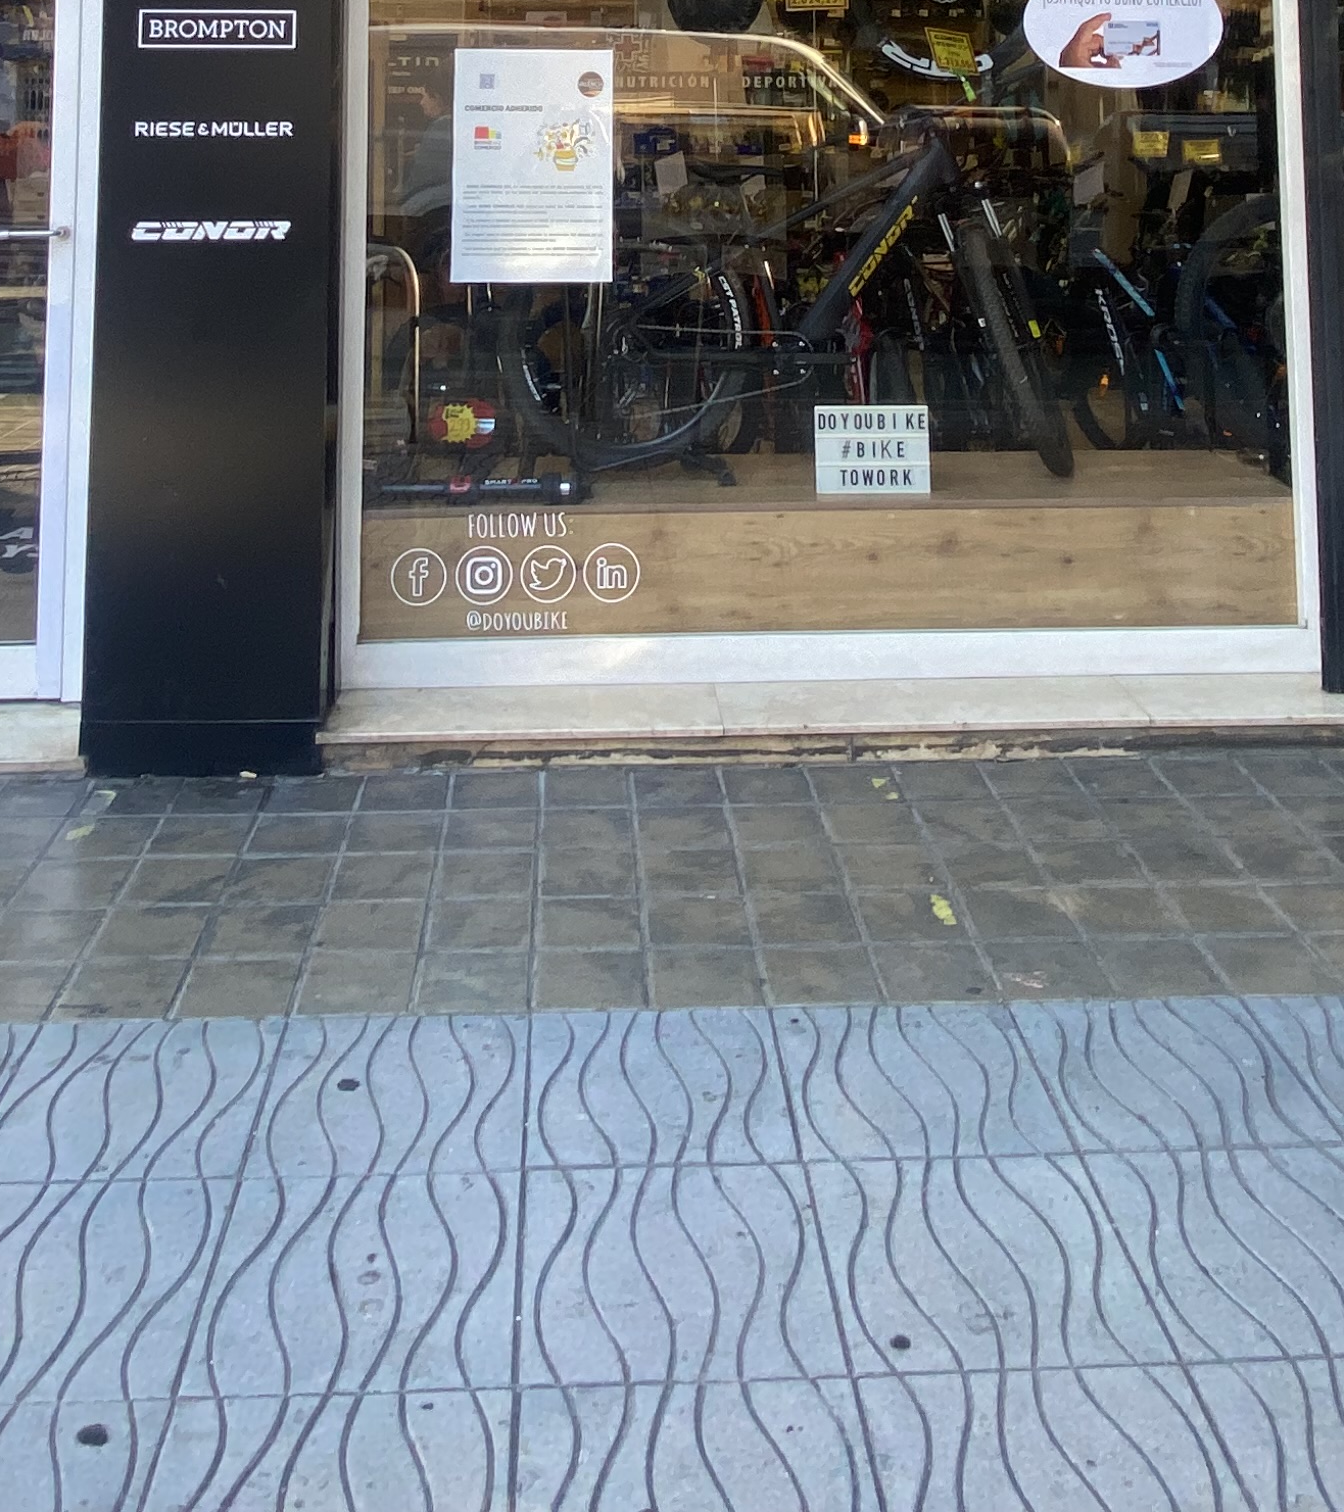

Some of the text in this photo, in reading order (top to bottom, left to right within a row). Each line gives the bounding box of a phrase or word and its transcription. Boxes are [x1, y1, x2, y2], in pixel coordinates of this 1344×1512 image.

[149, 19, 286, 39] BROMPTON
[729, 299, 743, 349] PATROL
[841, 439, 906, 459] #BIKE
[840, 469, 913, 487] TOWORK
[468, 513, 537, 538] FOLLOW
[466, 610, 568, 631] @DOYOUBIKE
